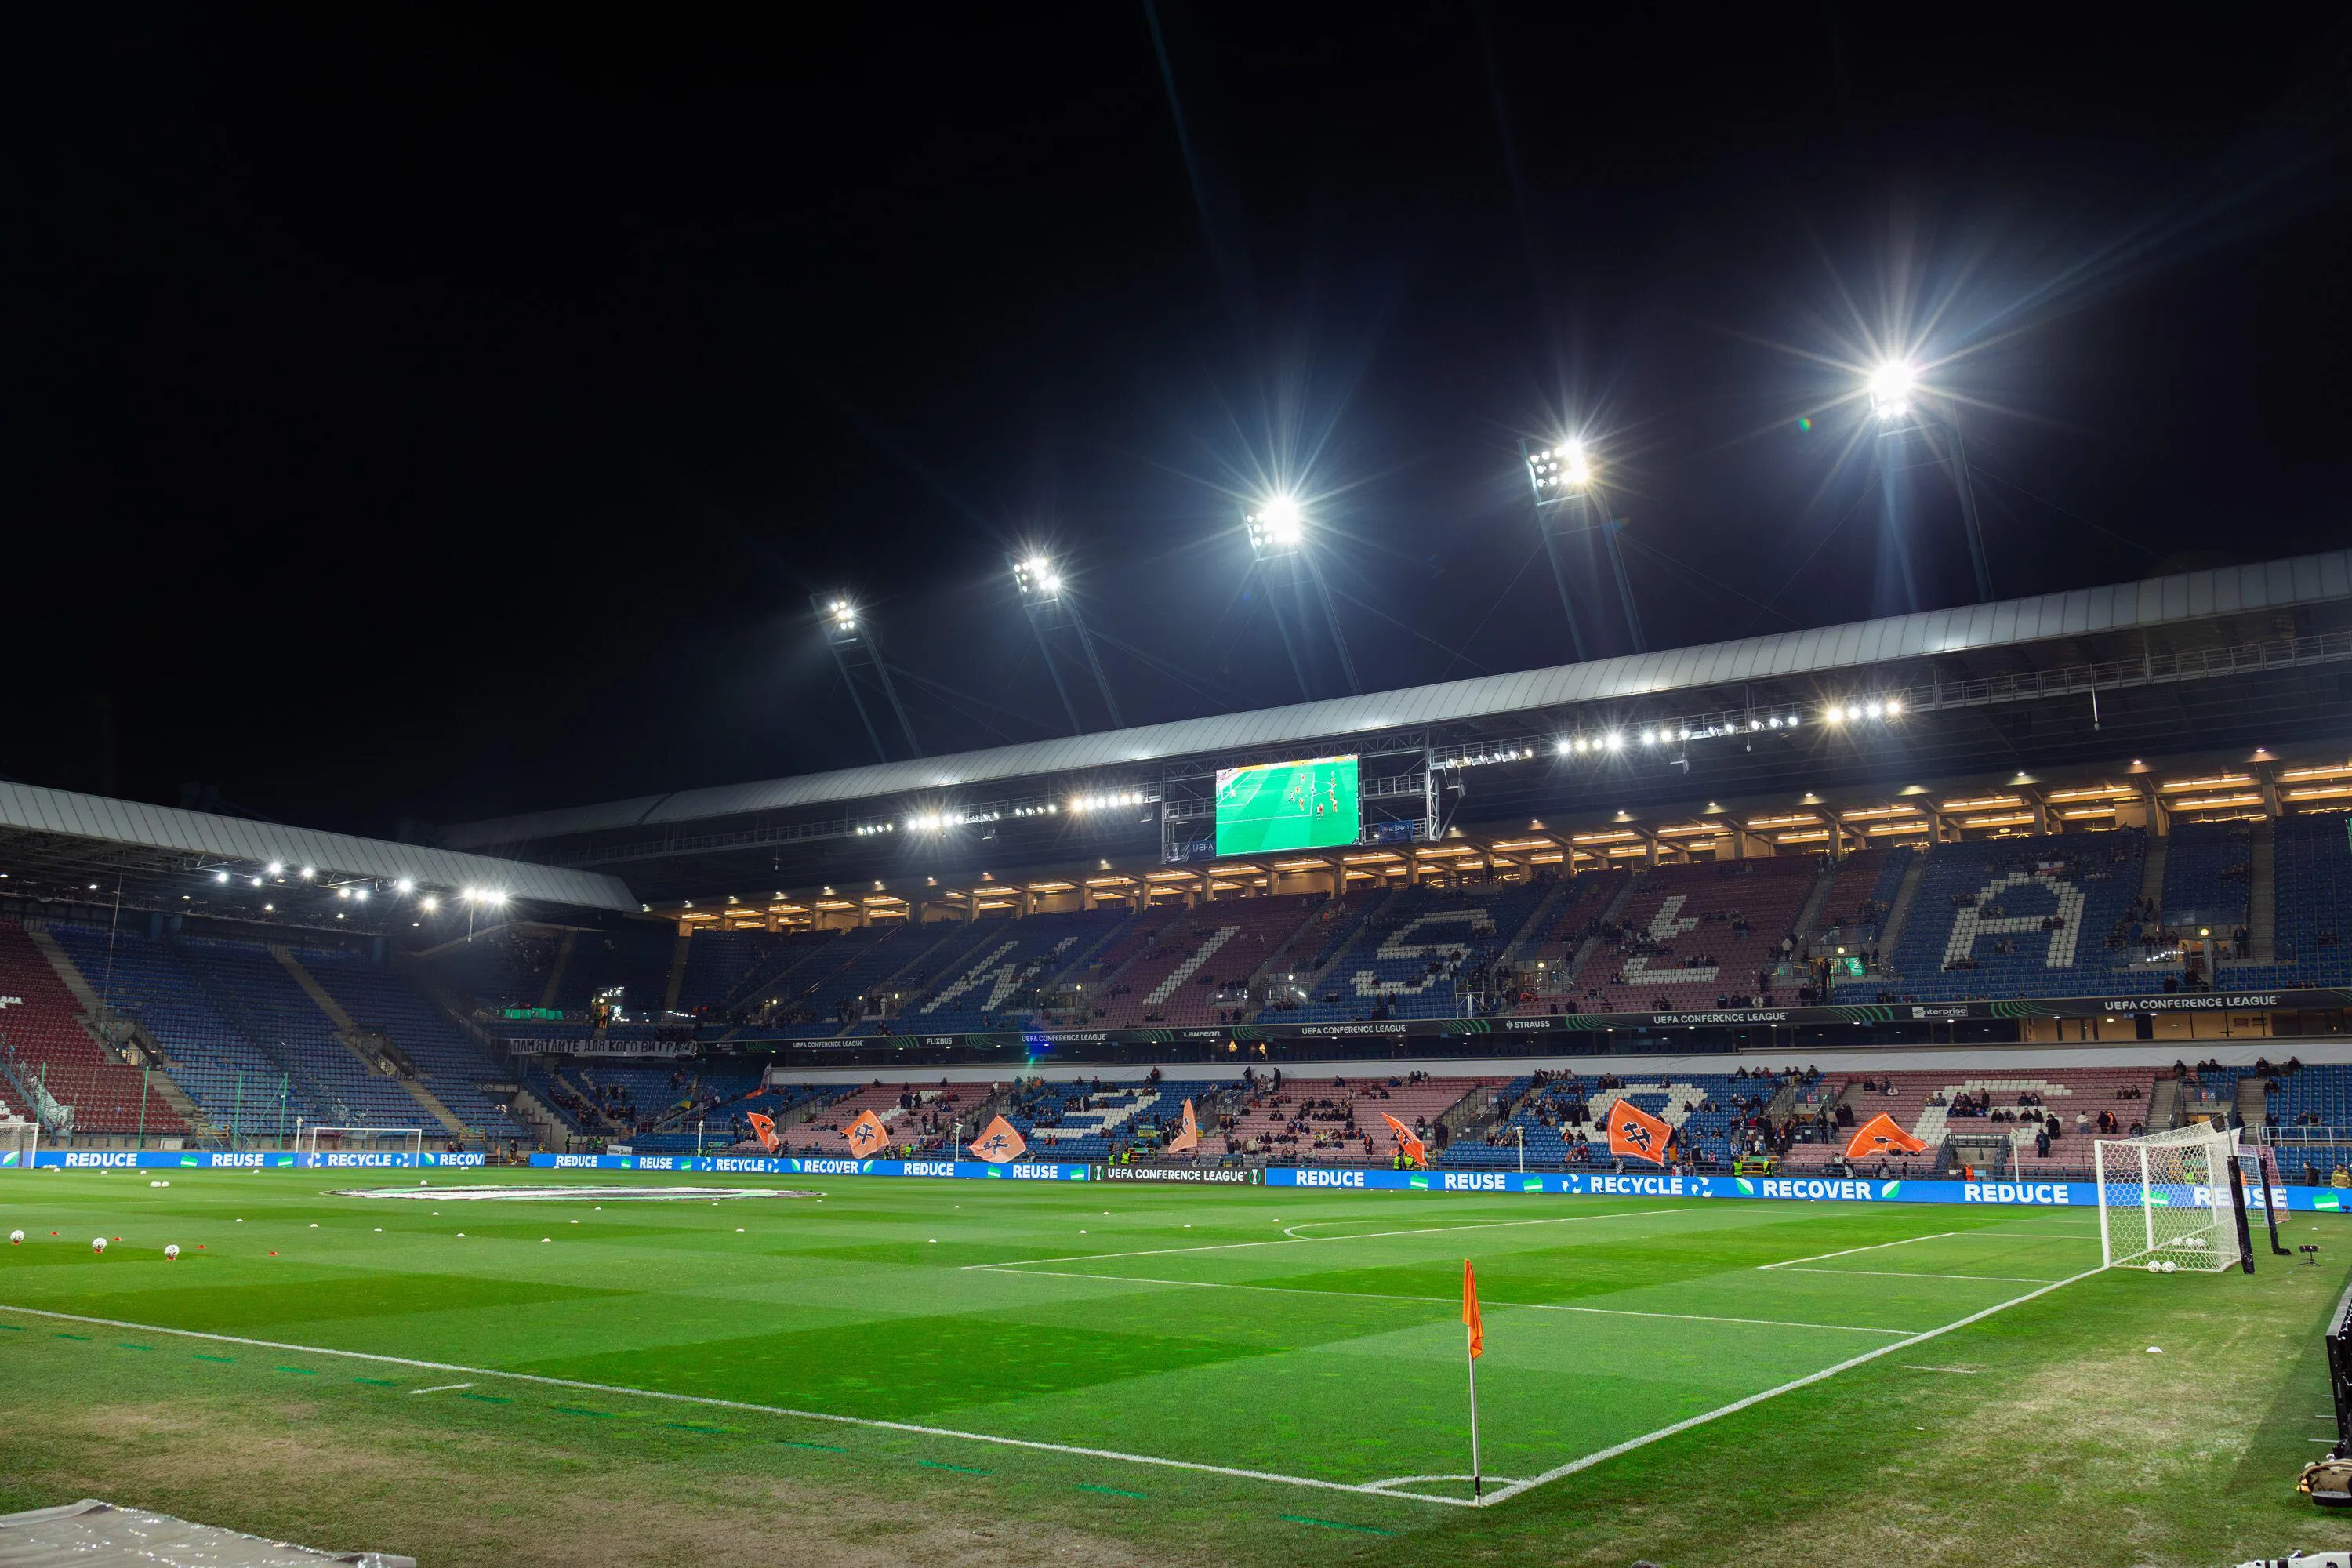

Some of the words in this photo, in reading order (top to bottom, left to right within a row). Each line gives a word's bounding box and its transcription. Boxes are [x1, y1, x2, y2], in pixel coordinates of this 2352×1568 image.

[2104, 1000, 2138, 1011] UEFA
[2140, 997, 2223, 1009] CONFERENCE
[2226, 996, 2278, 1007] LEAGUE
[1515, 1020, 1551, 1029] STRAUSS
[1653, 1015, 1679, 1024] UEFA
[1680, 1014, 1744, 1023] CONFERENCE
[1745, 1012, 1786, 1022] LEAGUE
[1375, 1024, 1406, 1033] LEAGUE
[608, 1040, 638, 1052] КОГО
[65, 1152, 137, 1167] REDUCE
[211, 1152, 265, 1167] REUSE
[328, 1153, 392, 1167] RECYCLE
[439, 1153, 483, 1167] RECOV
[556, 1155, 597, 1168] REDUCE
[639, 1156, 673, 1170] REUSE
[716, 1158, 765, 1172] RECYCLE
[804, 1160, 859, 1174] RECOVER
[903, 1162, 955, 1177] REDUCE
[1012, 1164, 1058, 1179] REUSE
[1107, 1167, 1132, 1178] UEFA
[1134, 1168, 1201, 1181] CONFERENCE
[1203, 1170, 1243, 1181] LEAGUE
[1296, 1171, 1364, 1187] REDUCE
[1444, 1173, 1506, 1190] REUSE
[1590, 1176, 1683, 1196] RECYCLE
[1762, 1180, 1872, 1200] RECOVER
[1964, 1183, 2069, 1204] REDUCE
[2194, 1185, 2288, 1208] REUSE
